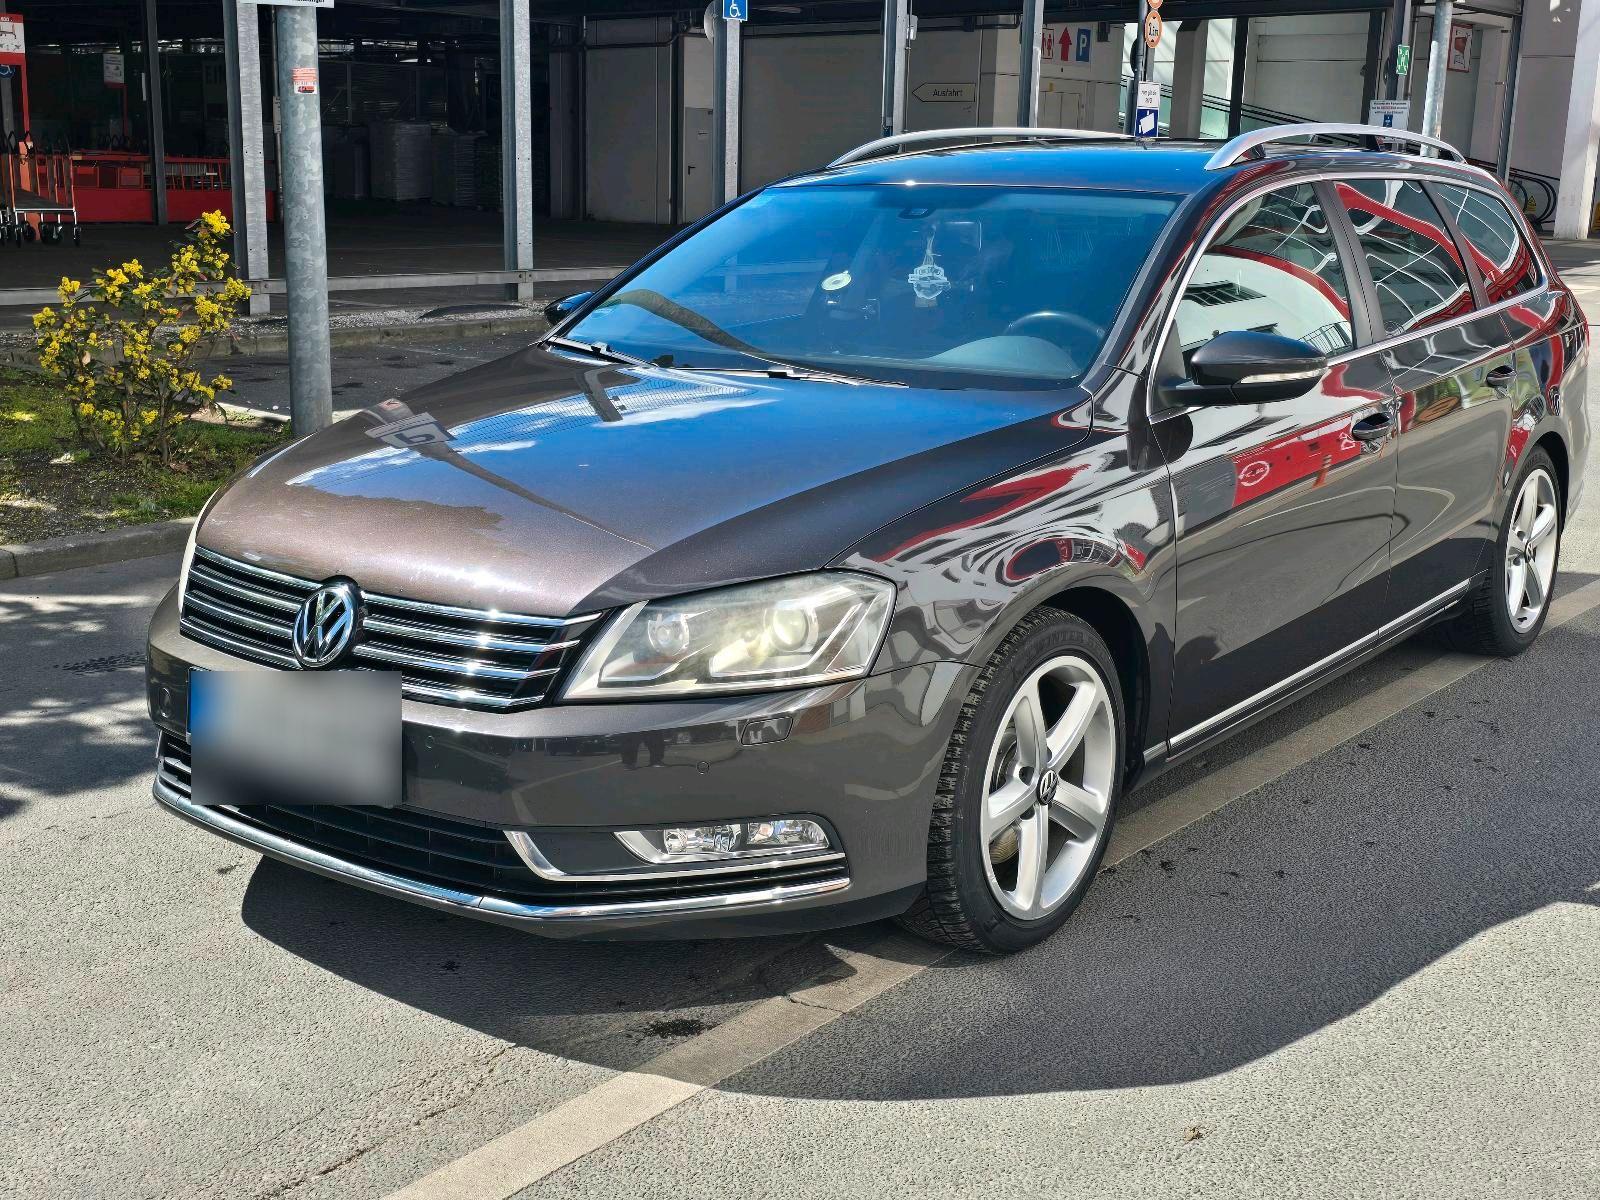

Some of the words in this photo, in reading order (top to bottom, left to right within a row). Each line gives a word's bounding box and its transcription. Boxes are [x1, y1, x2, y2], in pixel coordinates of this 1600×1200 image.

[1079, 34, 1088, 57] P
[932, 88, 963, 97] Ausfahrt
[297, 587, 352, 664] VW
